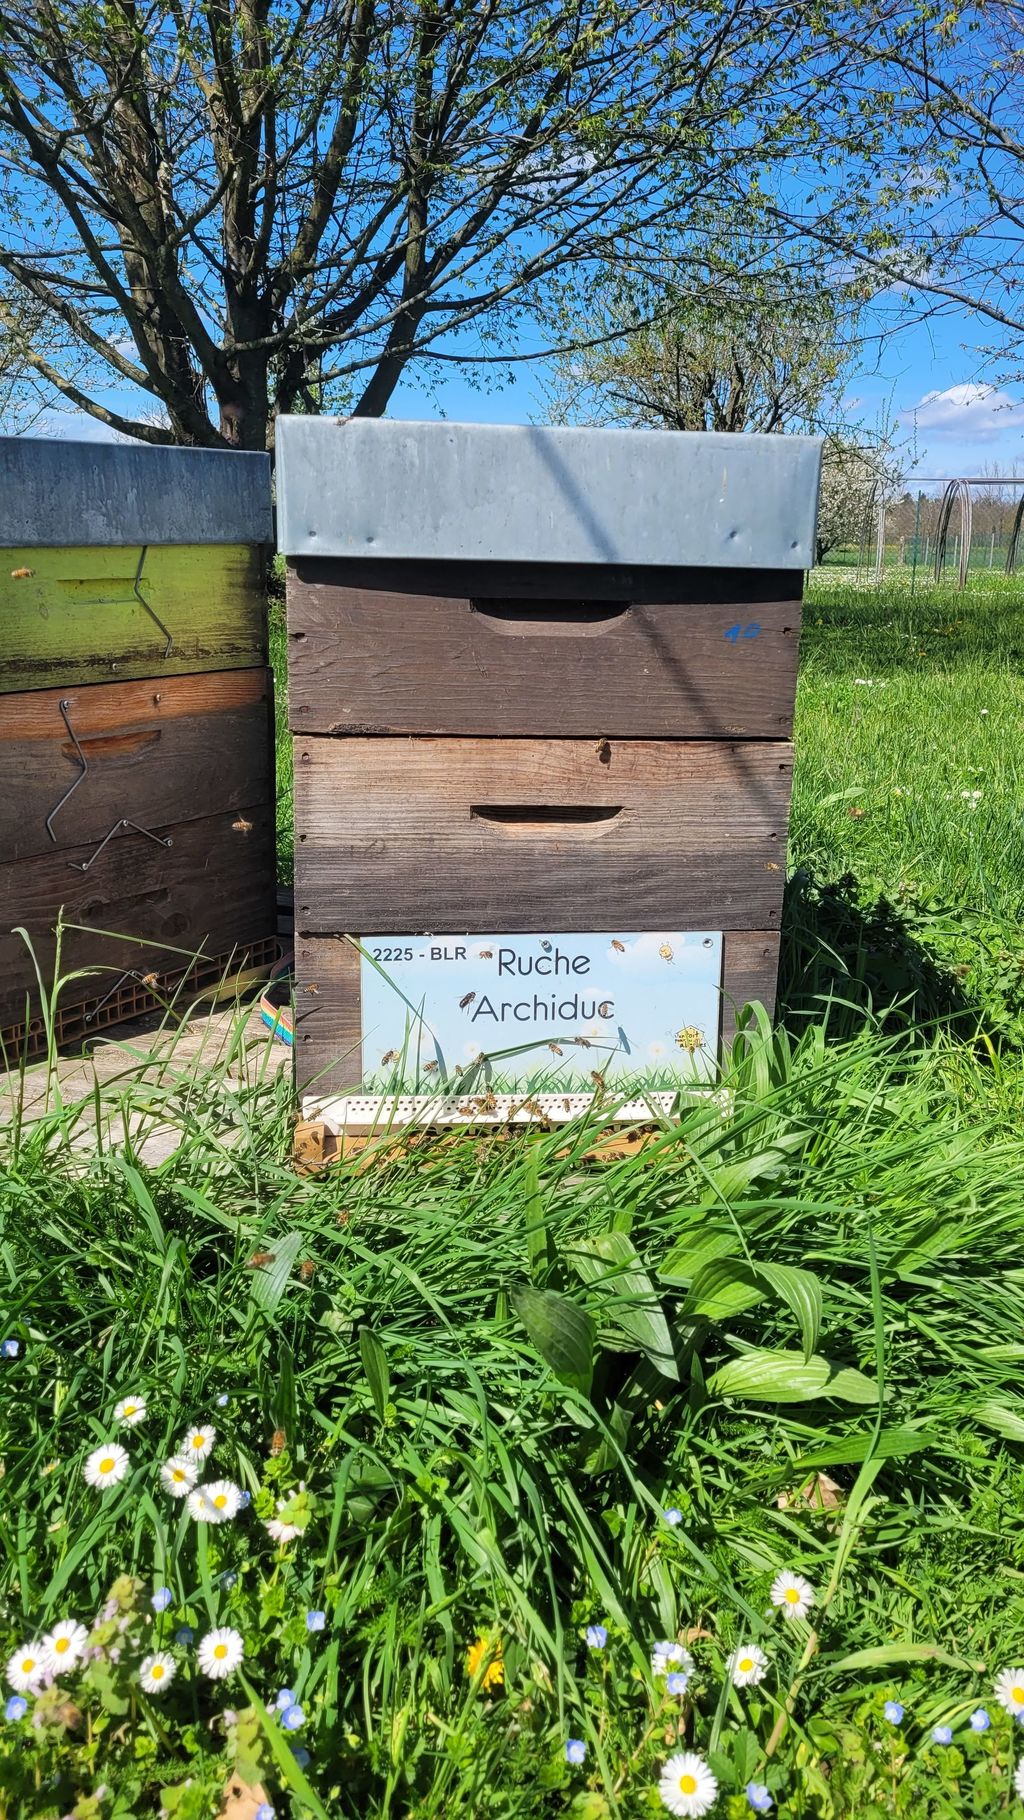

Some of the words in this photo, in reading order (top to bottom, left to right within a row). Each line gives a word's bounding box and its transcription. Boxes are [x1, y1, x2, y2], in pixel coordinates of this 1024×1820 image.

[372, 947, 413, 961] 2225
[430, 946, 467, 961] BLR
[498, 947, 591, 977] Ruche
[471, 993, 615, 1023] Archiduc
